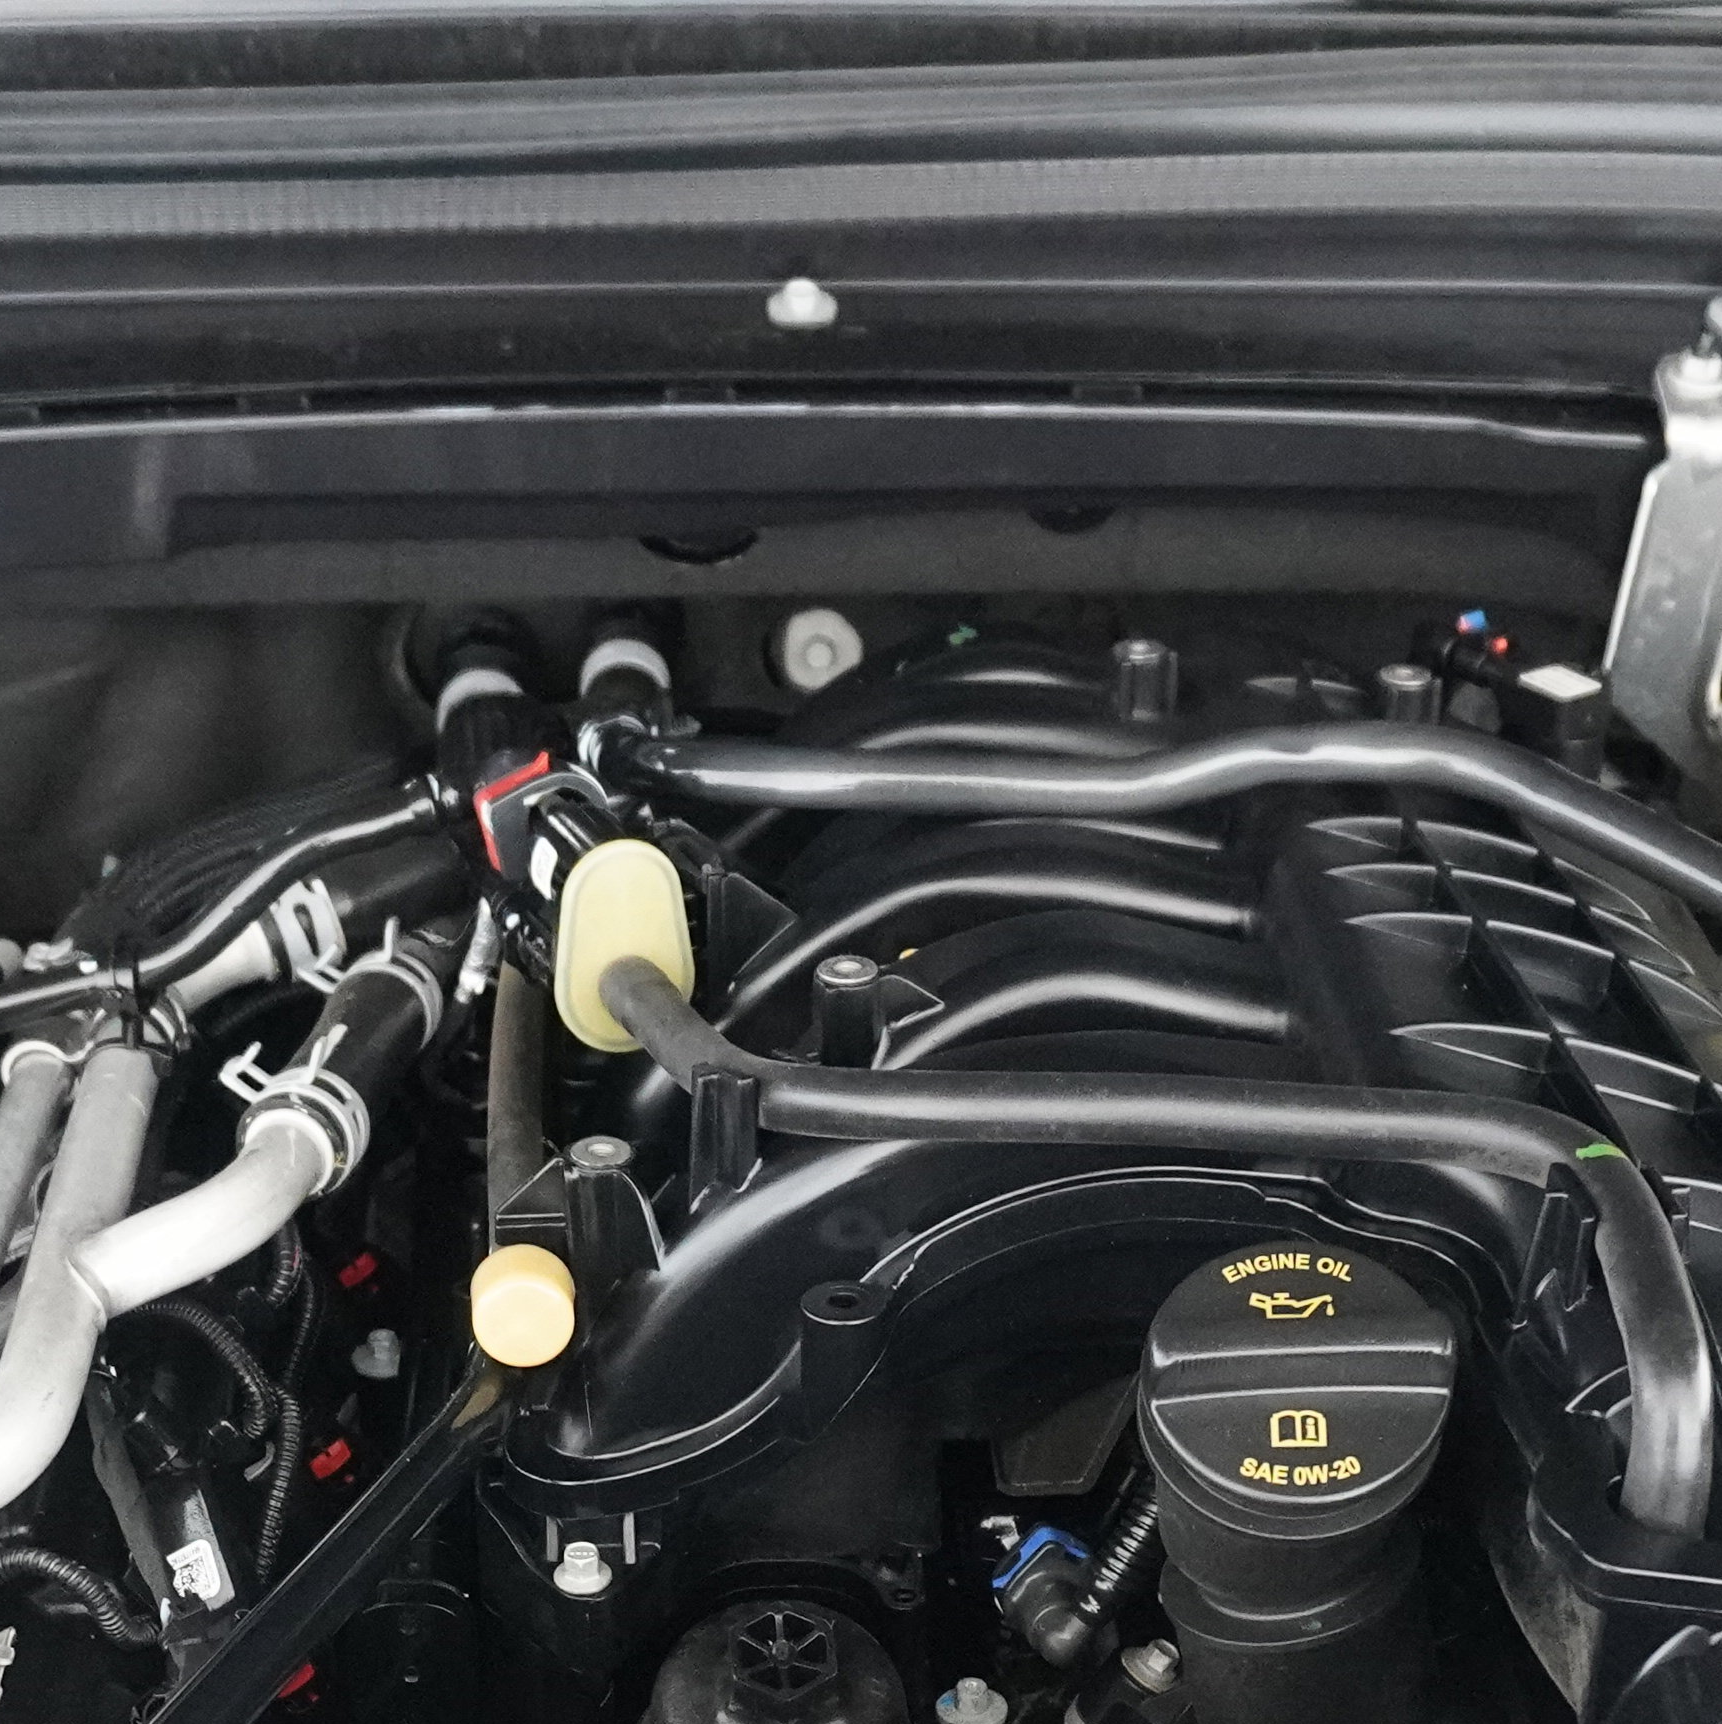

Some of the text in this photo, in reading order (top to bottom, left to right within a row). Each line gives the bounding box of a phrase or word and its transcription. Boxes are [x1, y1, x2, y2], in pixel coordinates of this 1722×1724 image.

[1221, 1252, 1354, 1285] ENGINE OIL
[1239, 1455, 1362, 1487] SAE 0W-20
